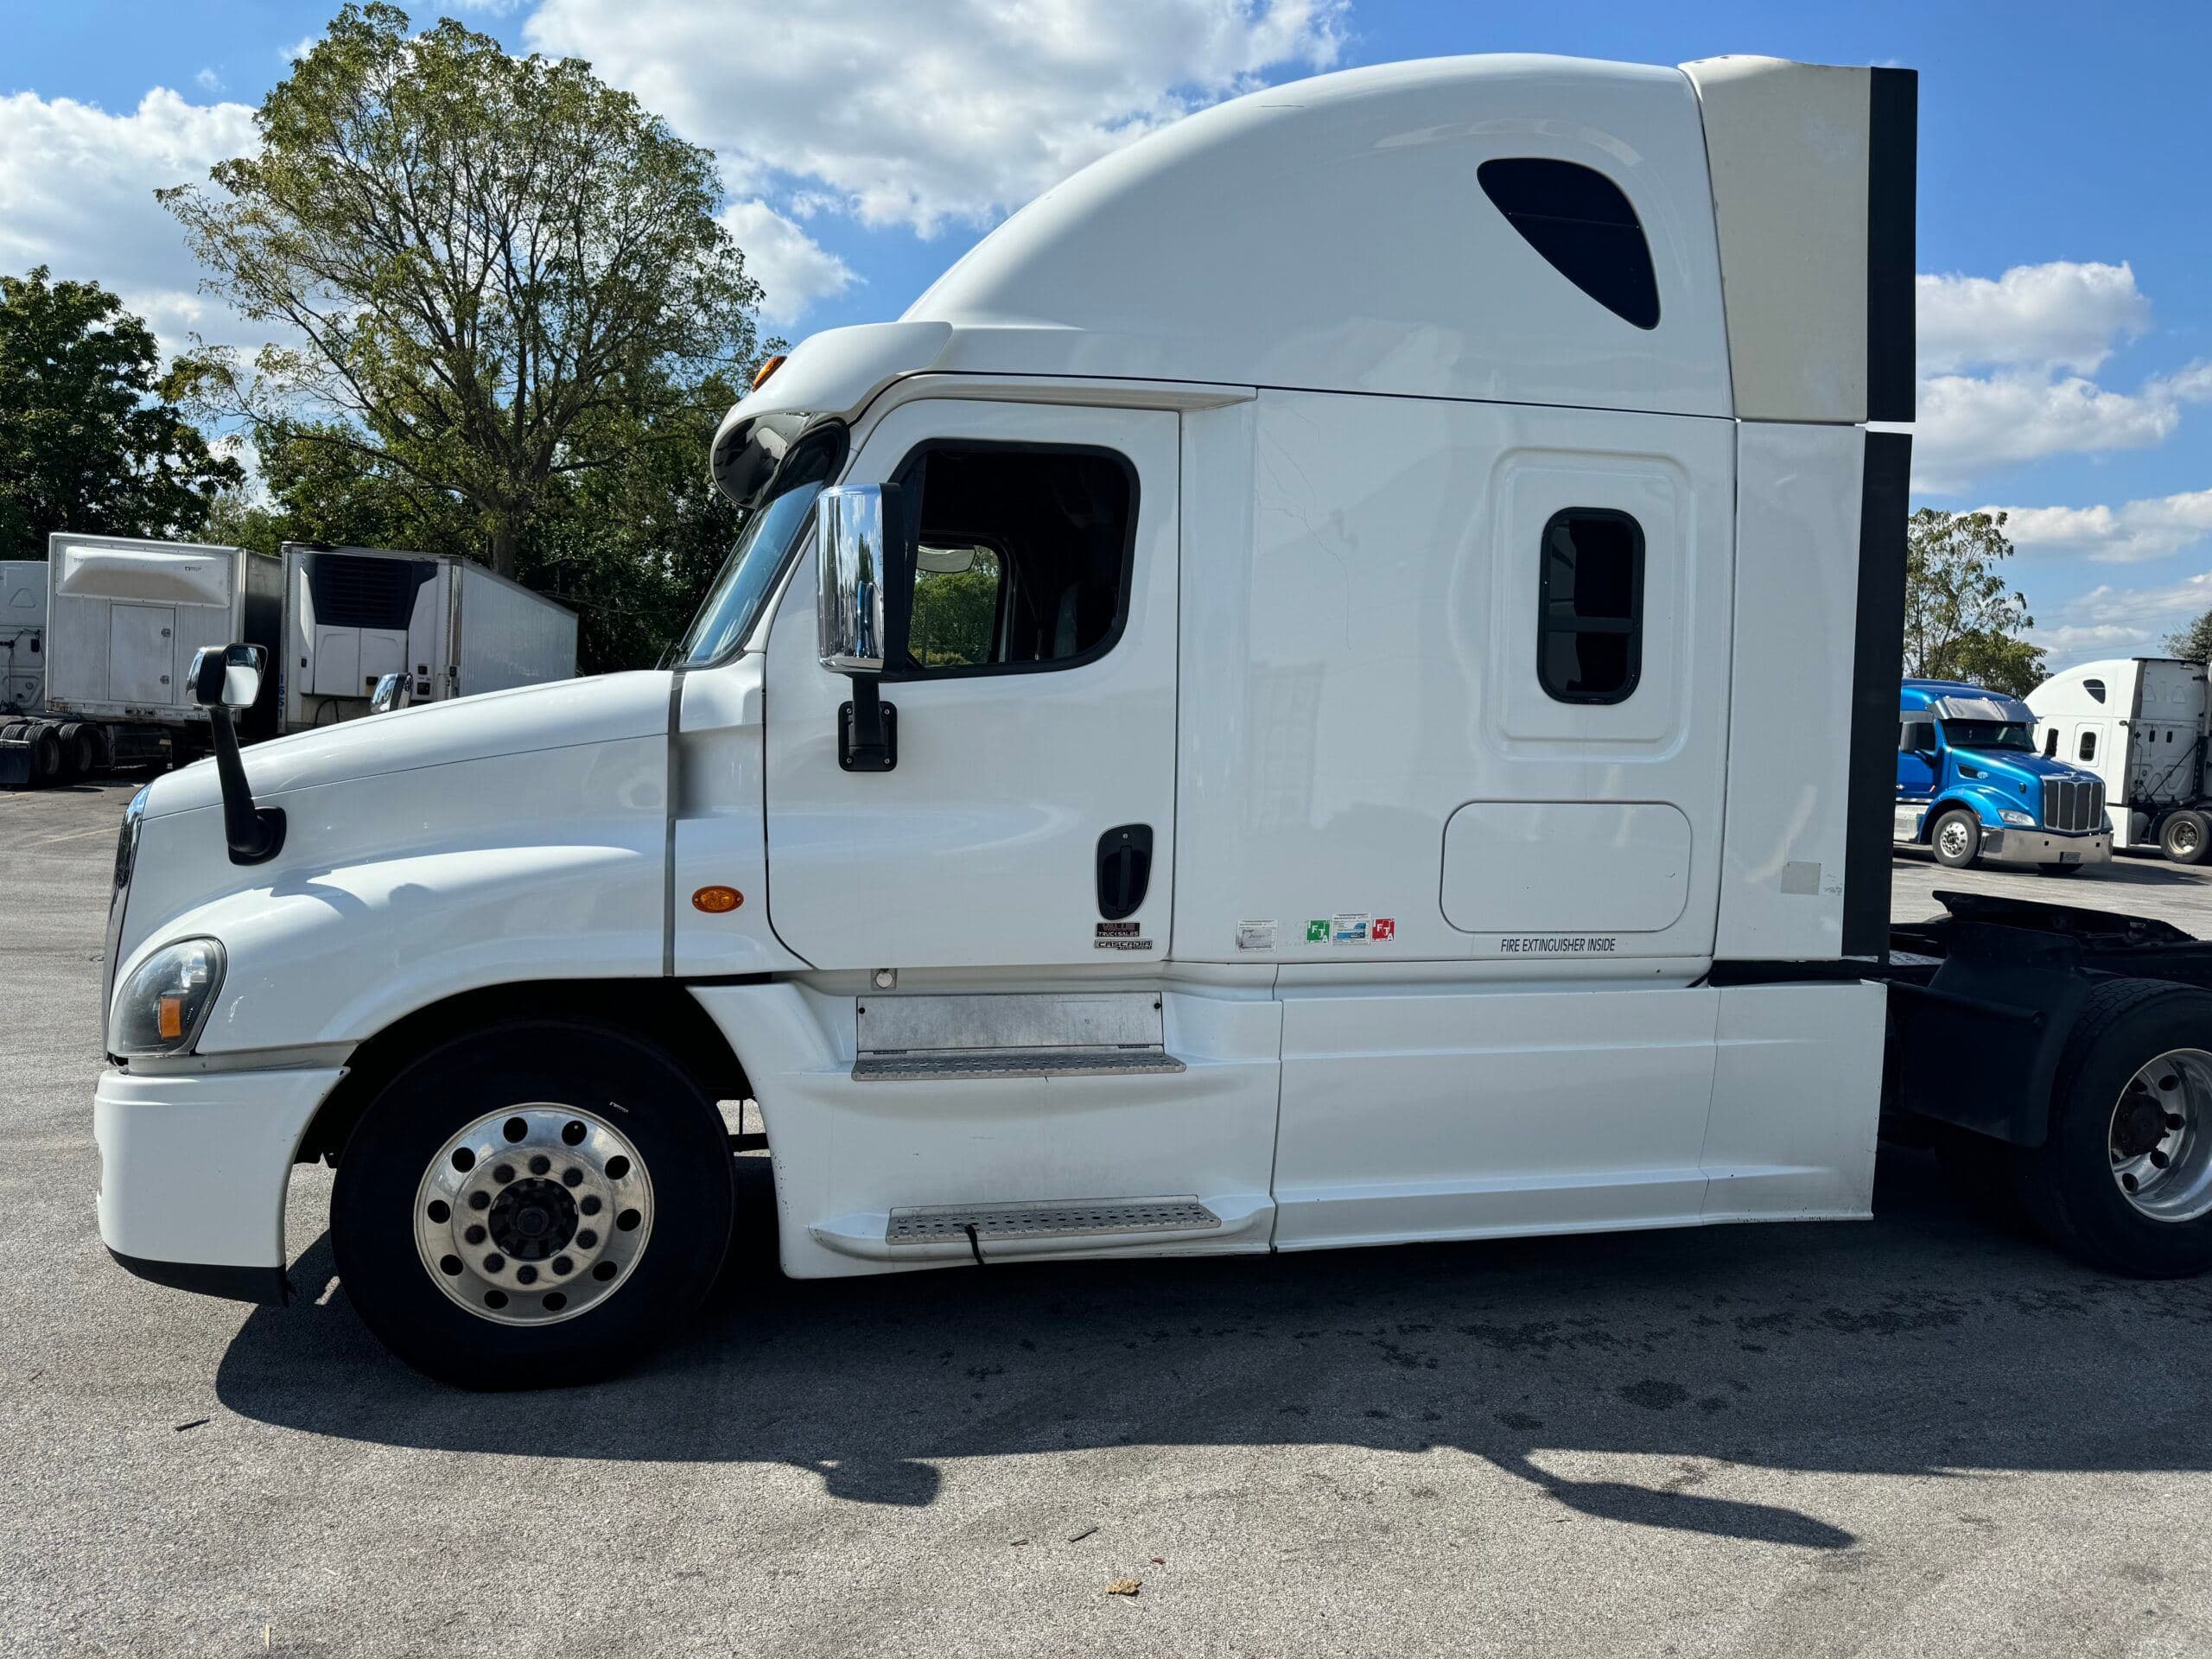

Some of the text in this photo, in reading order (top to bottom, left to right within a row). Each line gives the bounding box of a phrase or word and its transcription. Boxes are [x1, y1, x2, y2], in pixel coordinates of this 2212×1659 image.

[1307, 920, 1329, 944] IFTA
[1373, 918, 1394, 942] IFTA
[1096, 940, 1152, 949] CASCADIA
[1501, 938, 1617, 952] FIRE EXTINGUISHER INSIDE
